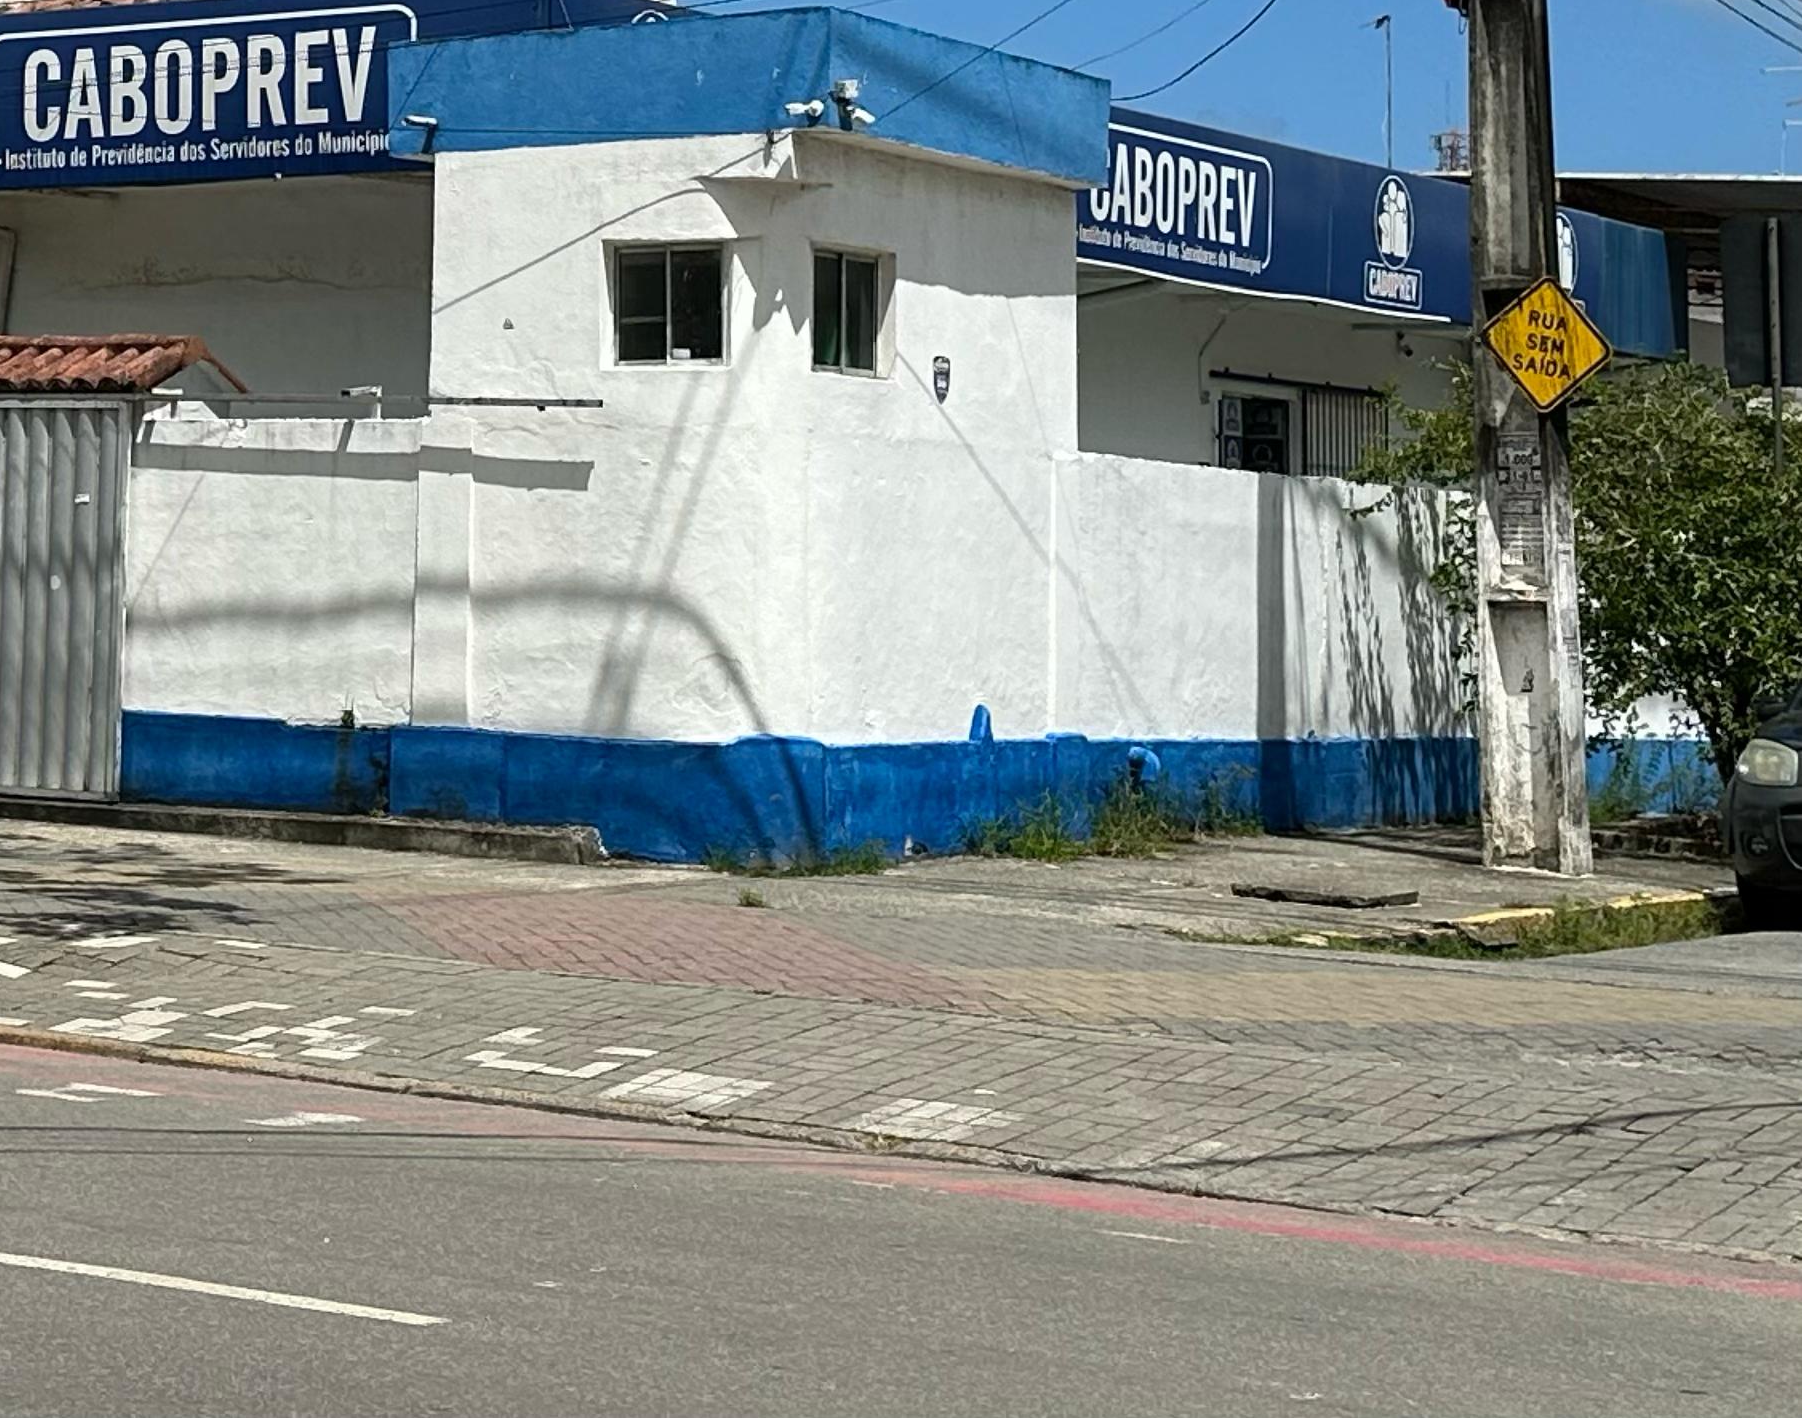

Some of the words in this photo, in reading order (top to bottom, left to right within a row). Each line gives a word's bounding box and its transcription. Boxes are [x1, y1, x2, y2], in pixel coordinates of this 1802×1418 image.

[24, 25, 377, 142] CABOPREV
[5, 145, 66, 170] Instituto
[69, 146, 88, 167] de
[91, 139, 176, 166] Previdência
[179, 139, 207, 162] dos
[210, 134, 290, 160] Servidores
[295, 133, 313, 156] do
[1527, 309, 1567, 332] RUA
[1525, 332, 1565, 358] SEM
[1511, 351, 1572, 381] SAÍDA
